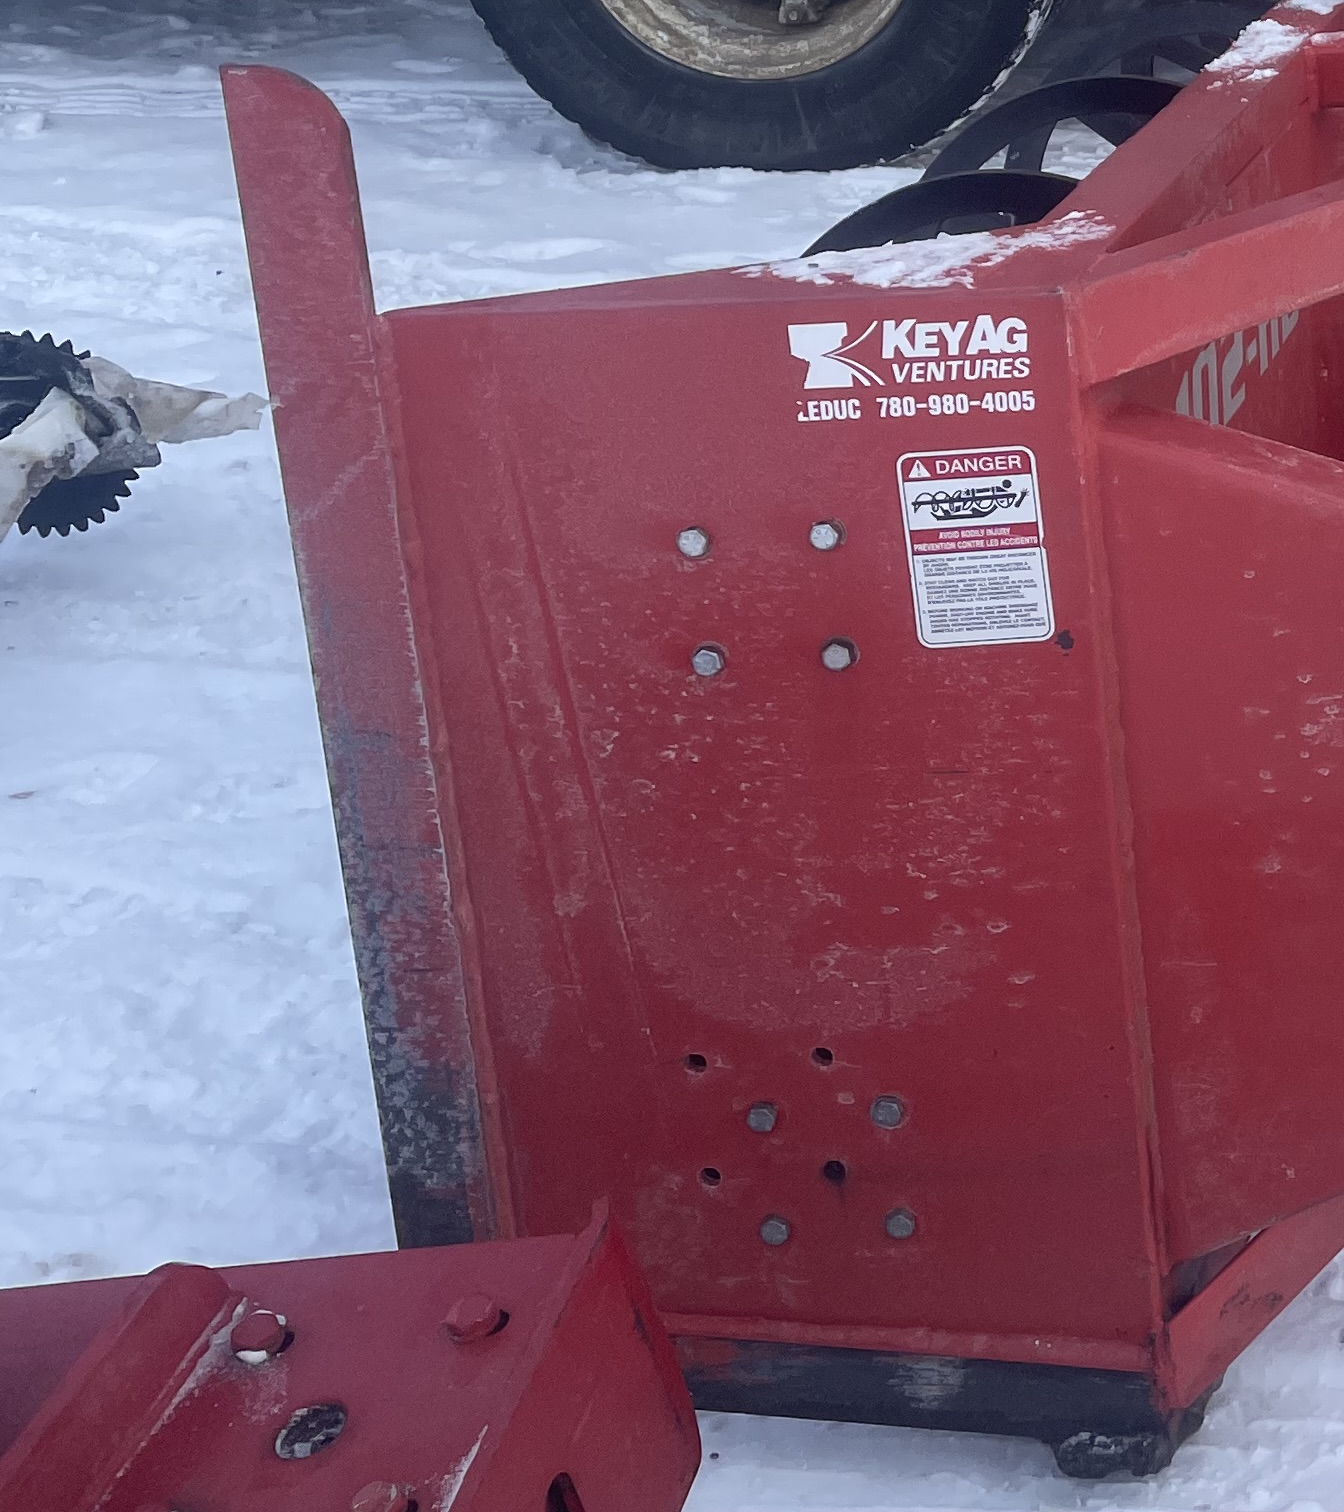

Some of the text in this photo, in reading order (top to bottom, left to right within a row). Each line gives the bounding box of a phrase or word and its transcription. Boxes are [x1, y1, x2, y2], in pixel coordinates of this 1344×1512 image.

[882, 314, 1029, 359] KEYAG
[892, 357, 1031, 384] VENTURES
[876, 390, 1036, 418] 780-980-4005
[935, 455, 1022, 475] DANGER
